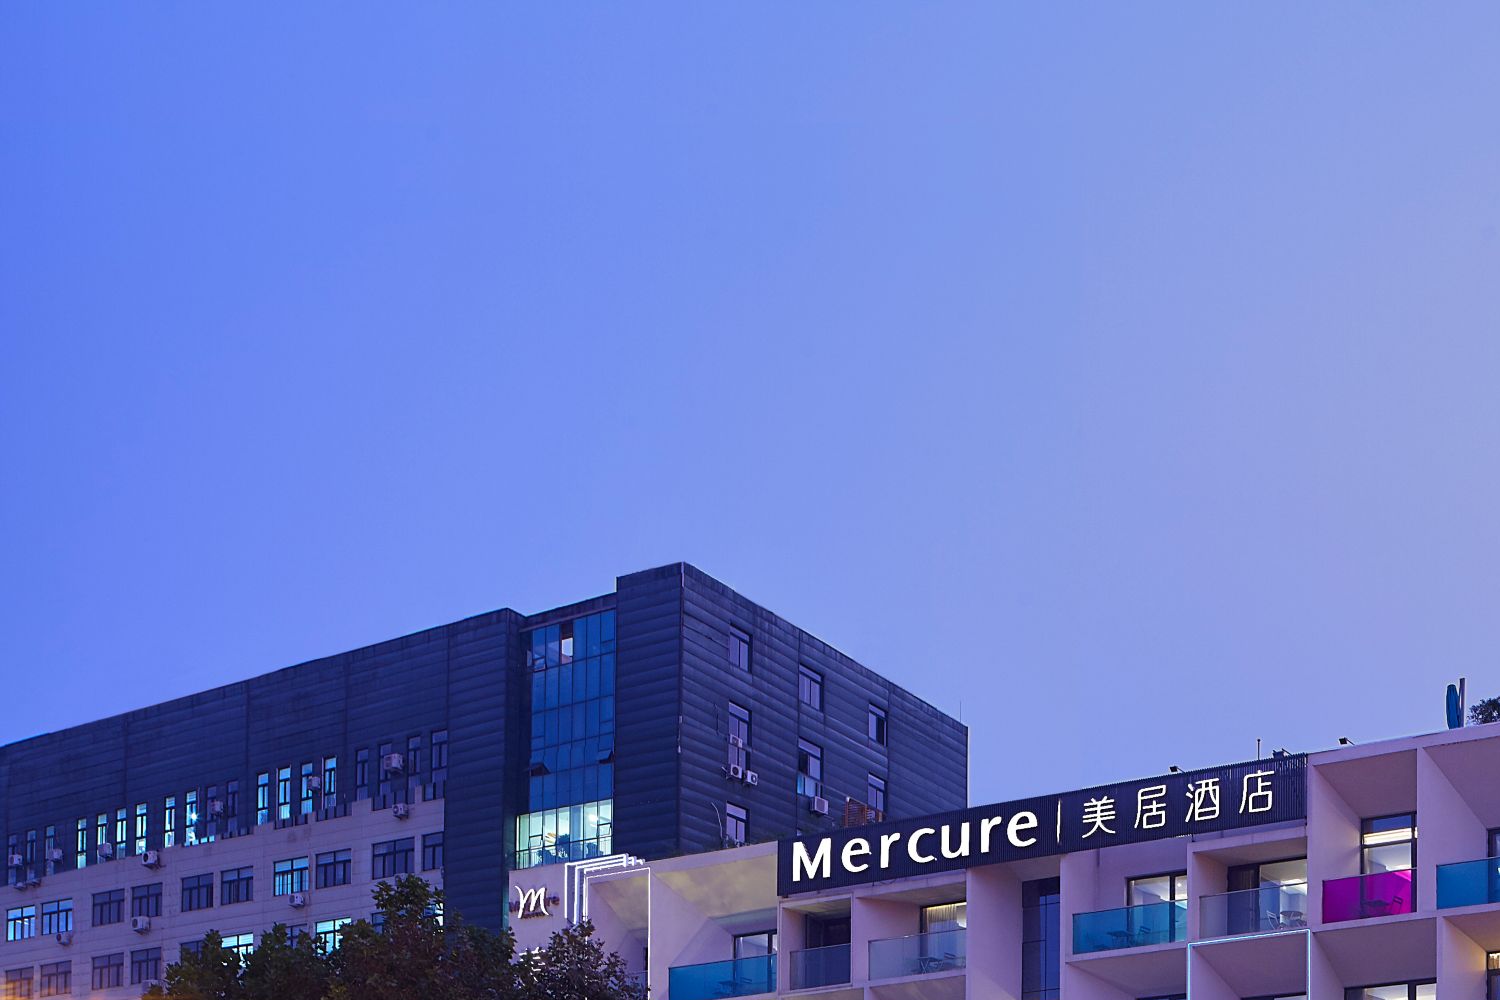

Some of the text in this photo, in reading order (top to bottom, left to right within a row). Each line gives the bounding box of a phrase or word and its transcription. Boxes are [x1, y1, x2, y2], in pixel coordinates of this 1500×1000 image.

[792, 770, 1275, 882] Mercure 美居酒店
